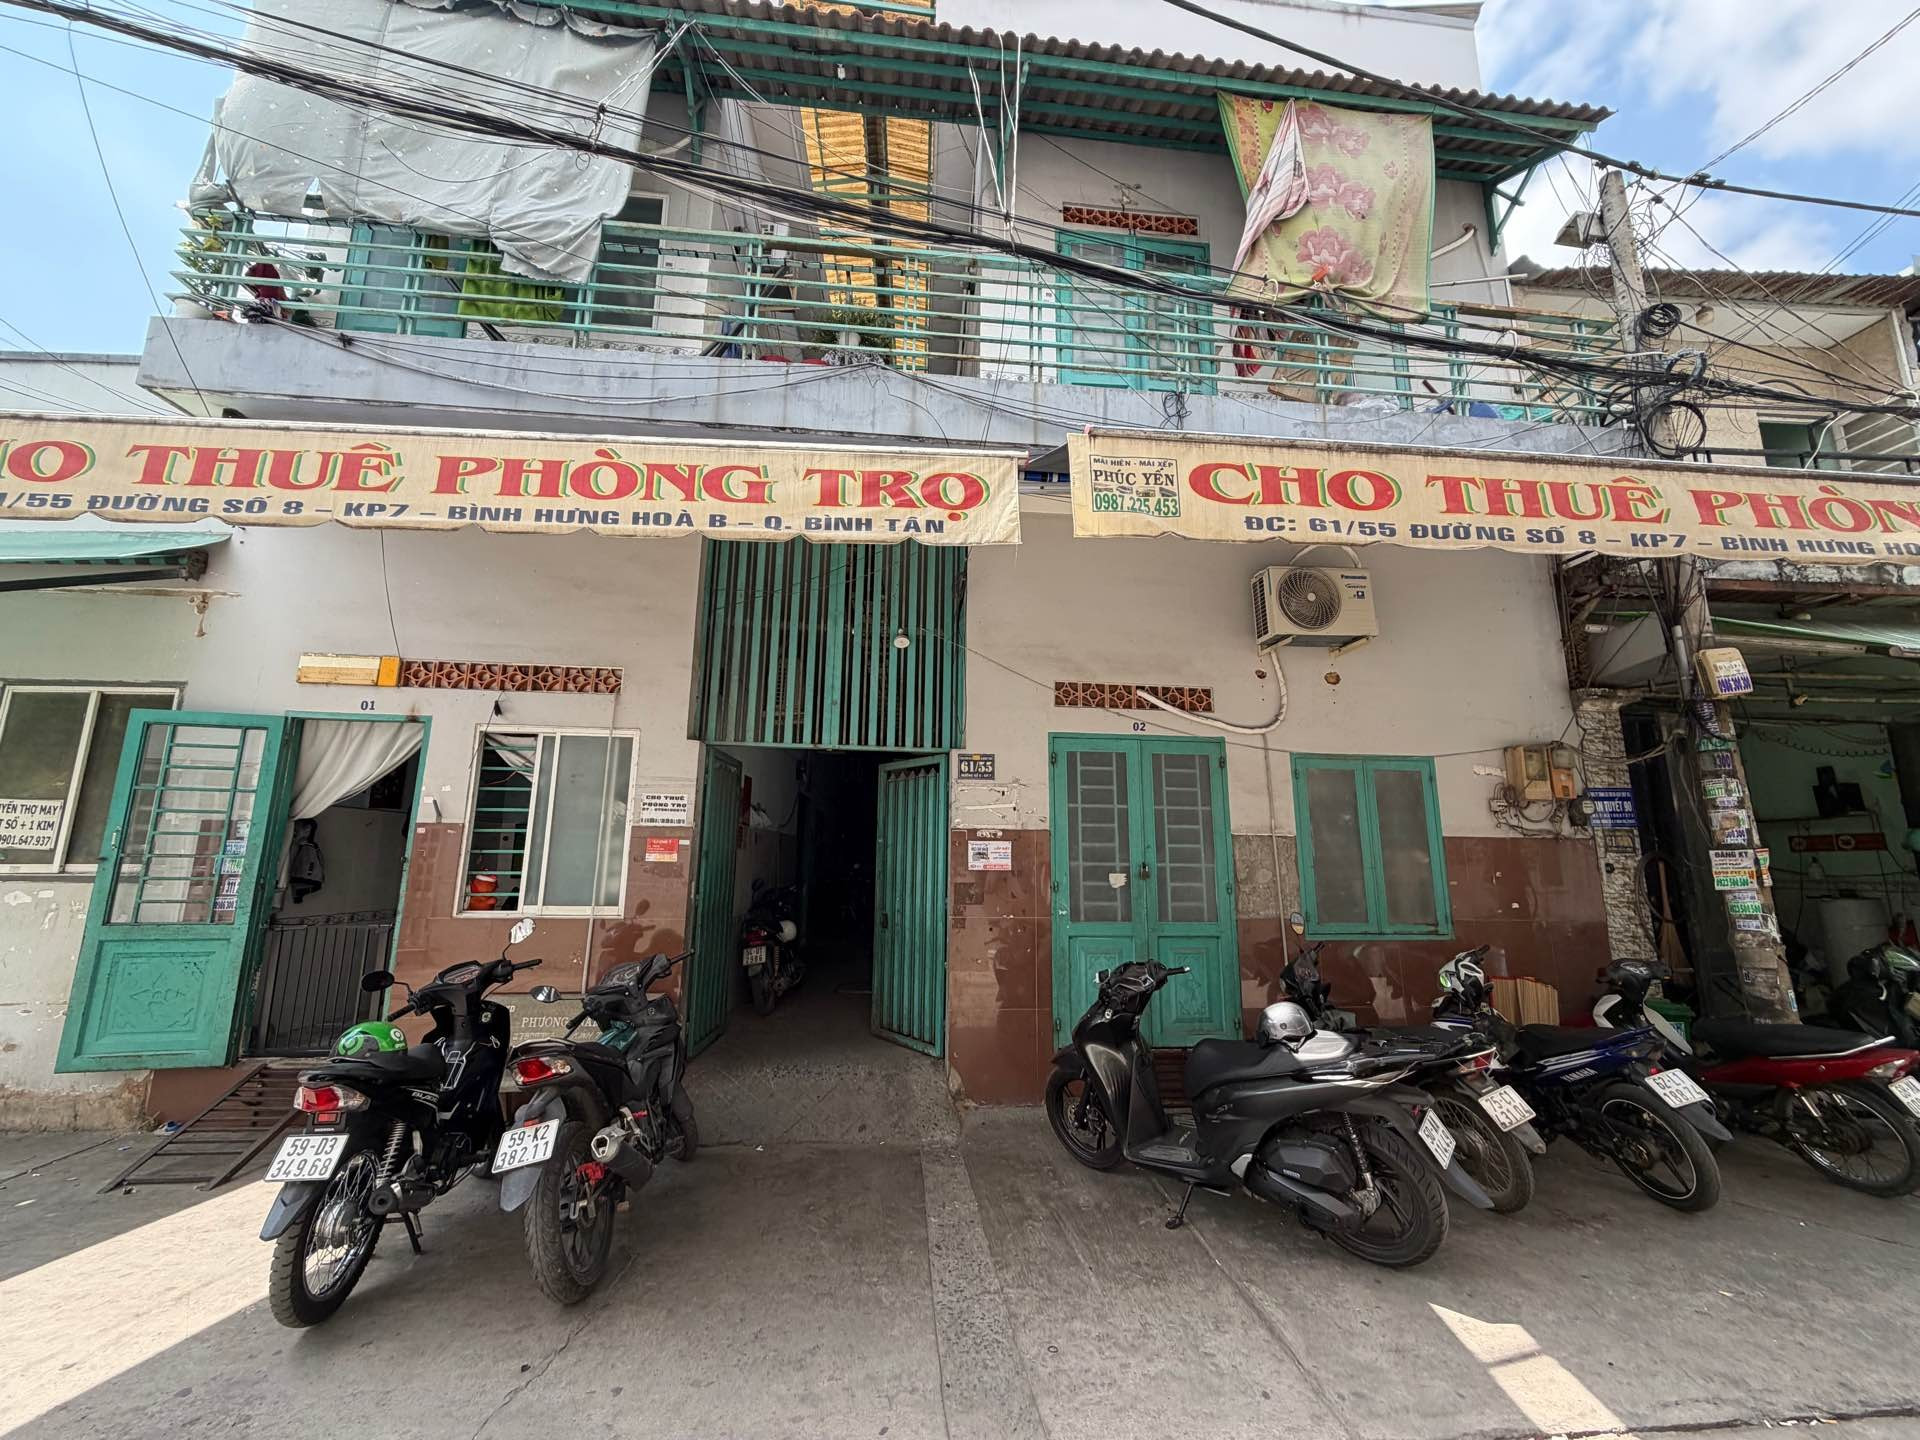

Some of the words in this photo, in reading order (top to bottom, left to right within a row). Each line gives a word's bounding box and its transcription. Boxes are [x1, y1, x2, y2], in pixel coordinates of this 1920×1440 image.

[0, 439, 96, 482] O
[126, 442, 405, 494] THUÊ
[430, 447, 778, 505] PHÒNG
[803, 468, 991, 522] TRỌ
[1093, 469, 1137, 486] PHÚC
[1142, 468, 1175, 487] YẾN
[1188, 462, 1402, 511] CHO
[1425, 474, 1671, 524] THUÊ
[86, 492, 210, 513] ĐƯỜNG
[222, 495, 273, 514] SỐ
[282, 500, 304, 515] 8
[343, 502, 409, 517] KP7
[447, 503, 522, 522] BÌNH
[534, 507, 620, 525] HƯNG
[631, 508, 695, 527] HOÀ
[708, 514, 727, 528] B
[764, 515, 792, 530] Q.
[804, 514, 873, 532] BÌNH
[884, 517, 945, 534] TÂN
[1244, 515, 1297, 532] ĐC:
[1308, 517, 1397, 538] 61/55
[1409, 522, 1516, 542] ĐƯỜNG
[1526, 525, 1566, 544] SỐ
[1578, 530, 1597, 545] 8
[1630, 532, 1688, 548] KP7
[1720, 533, 1790, 552] BÌNH
[1797, 538, 1877, 555] HƯNG
[361, 700, 376, 711] 01
[1133, 721, 1147, 733] 02
[960, 760, 993, 773] 61/55
[39, 804, 59, 816] MAY
[36, 820, 55, 831] KIM
[507, 1124, 550, 1149] 59-K2
[286, 1137, 338, 1157] 59-D3
[496, 1140, 550, 1169] 382.11
[270, 1158, 332, 1178] 349.68
